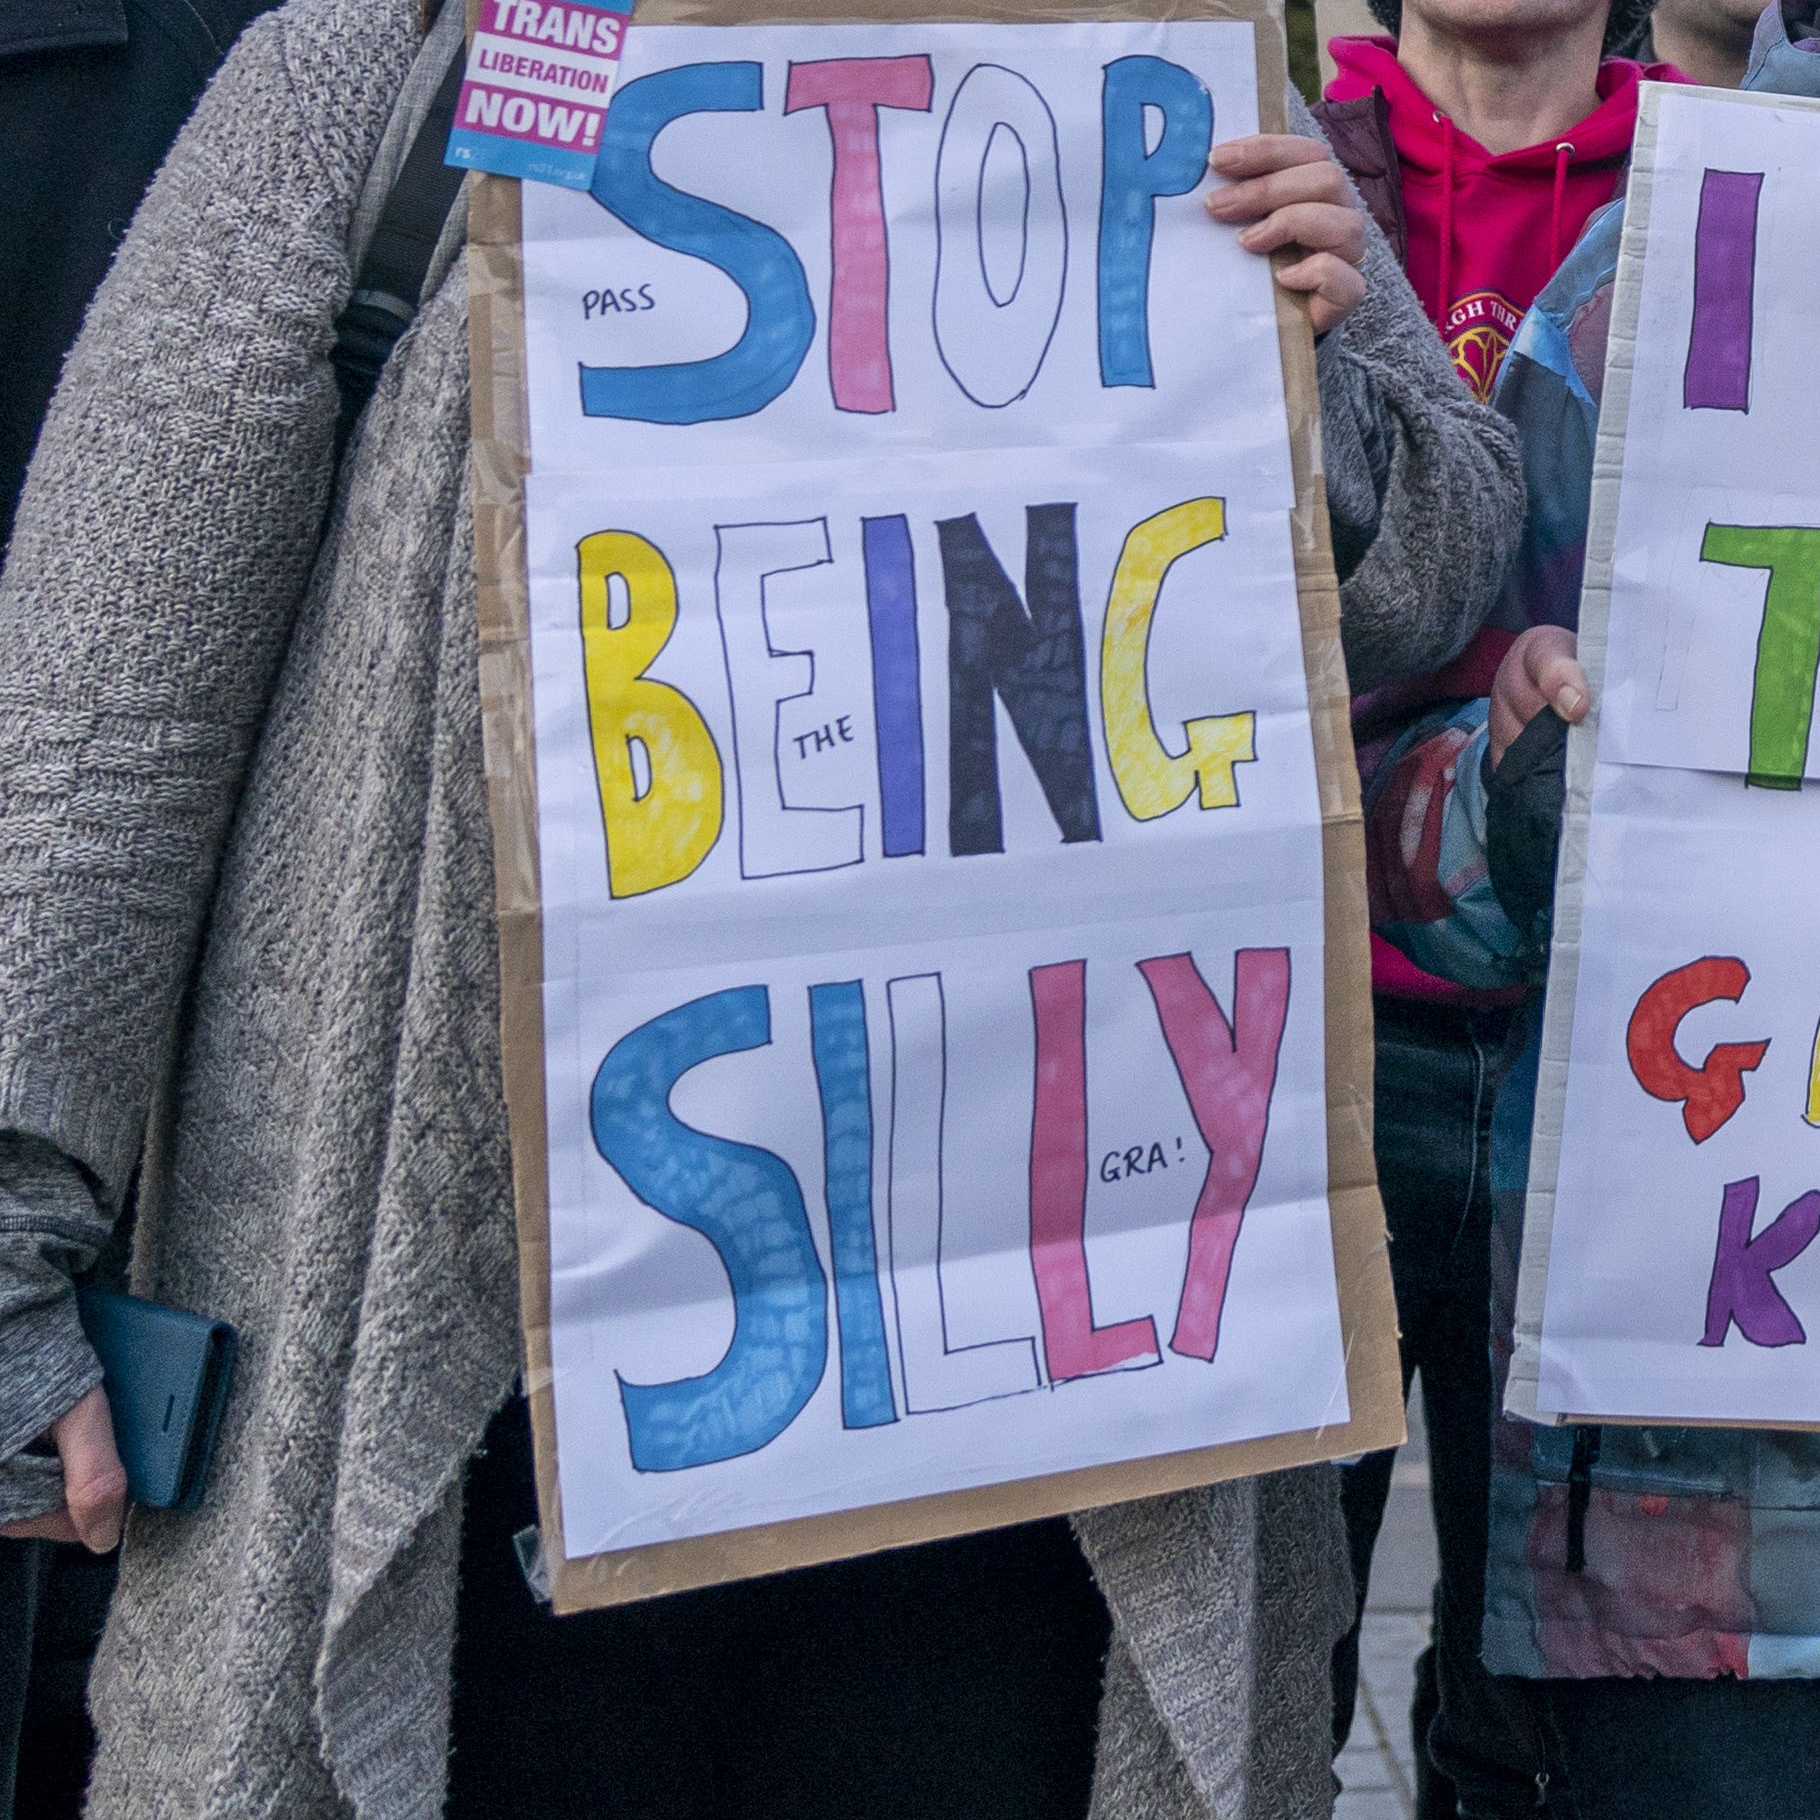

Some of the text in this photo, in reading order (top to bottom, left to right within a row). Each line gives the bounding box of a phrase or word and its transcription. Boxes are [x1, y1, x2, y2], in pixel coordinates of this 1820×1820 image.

[465, 89, 601, 147] NOW!
[478, 48, 609, 94] LIBERATION
[579, 54, 1214, 425] STOP
[582, 285, 656, 320] PASS
[1683, 168, 1765, 412] I
[577, 497, 1257, 900] BEING
[792, 717, 855, 760] THE
[590, 947, 1290, 1473] SILLY
